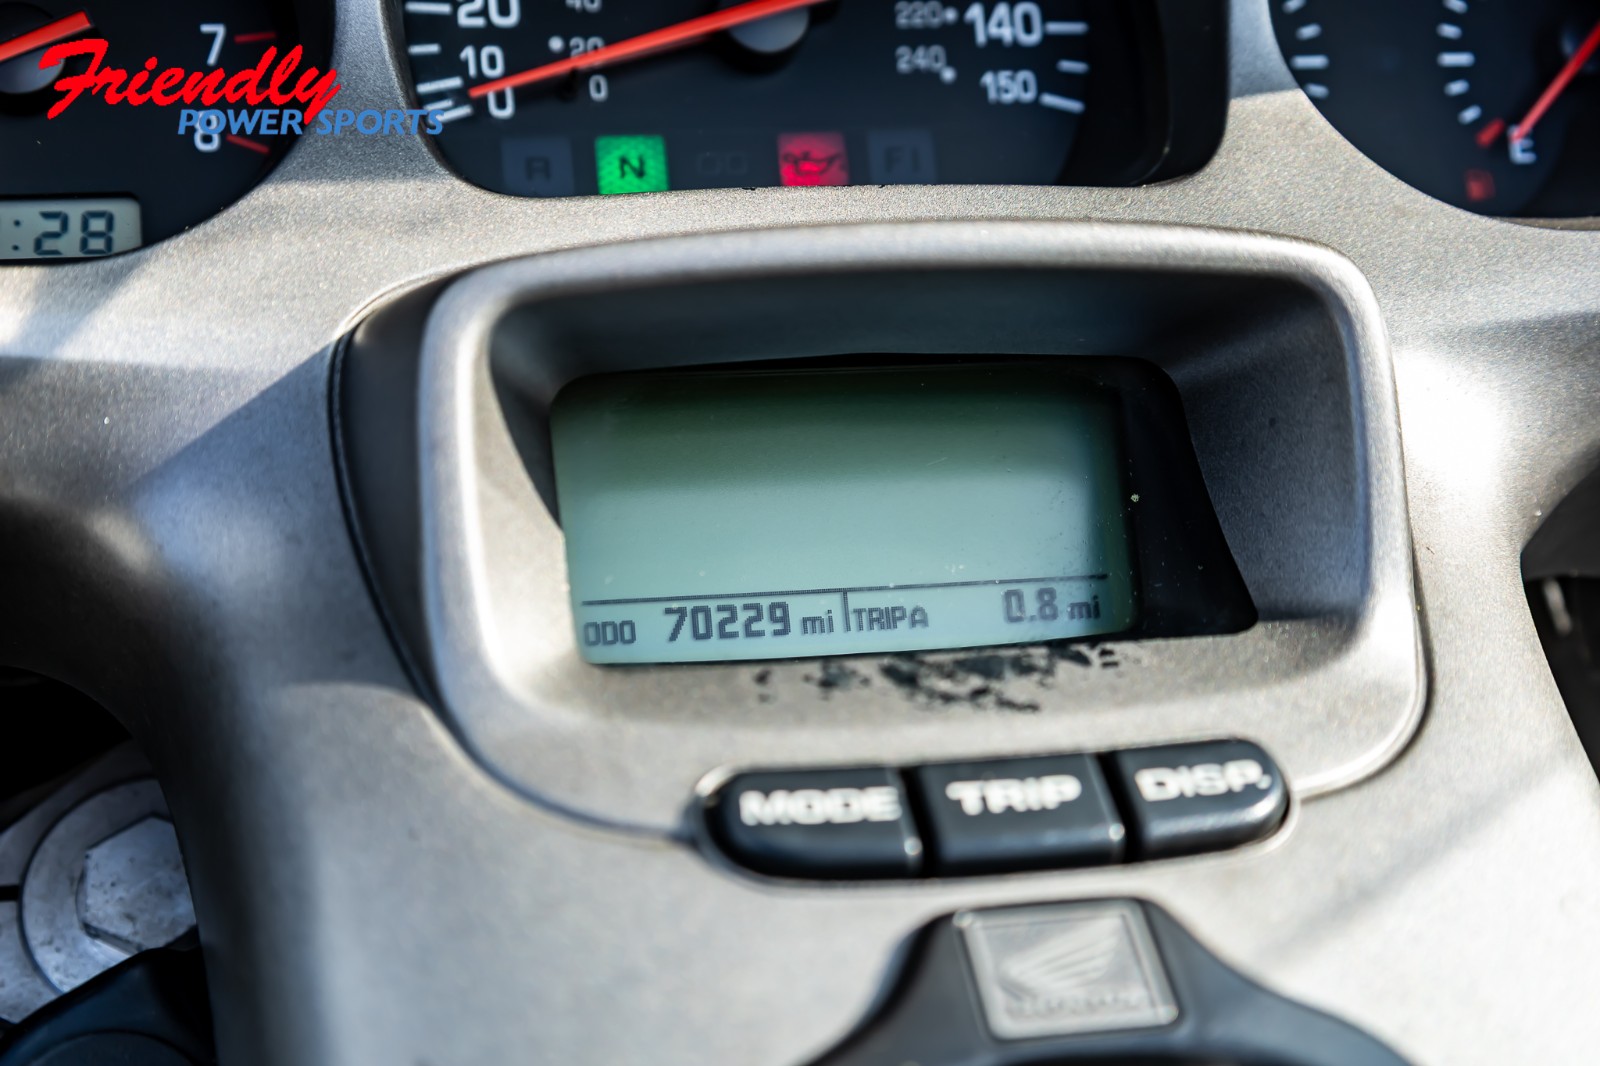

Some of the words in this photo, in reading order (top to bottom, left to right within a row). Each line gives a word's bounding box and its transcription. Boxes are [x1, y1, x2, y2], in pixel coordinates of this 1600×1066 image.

[457, 0, 521, 28] 20
[895, 0, 943, 29] 220
[964, 1, 1043, 47] 140
[200, 23, 226, 66] 7
[459, 45, 505, 79] 10
[895, 44, 946, 74] 240
[589, 74, 609, 102] 0
[980, 69, 1037, 105] 150
[618, 154, 646, 179] N
[583, 619, 637, 646] ODO
[664, 601, 791, 642] 70229
[802, 608, 834, 634] mi
[1004, 587, 1059, 624] 0.8
[1068, 595, 1100, 620] mi
[944, 774, 1082, 816] TRIP
[1134, 759, 1273, 801] DISP.
[739, 786, 902, 826] MODE
